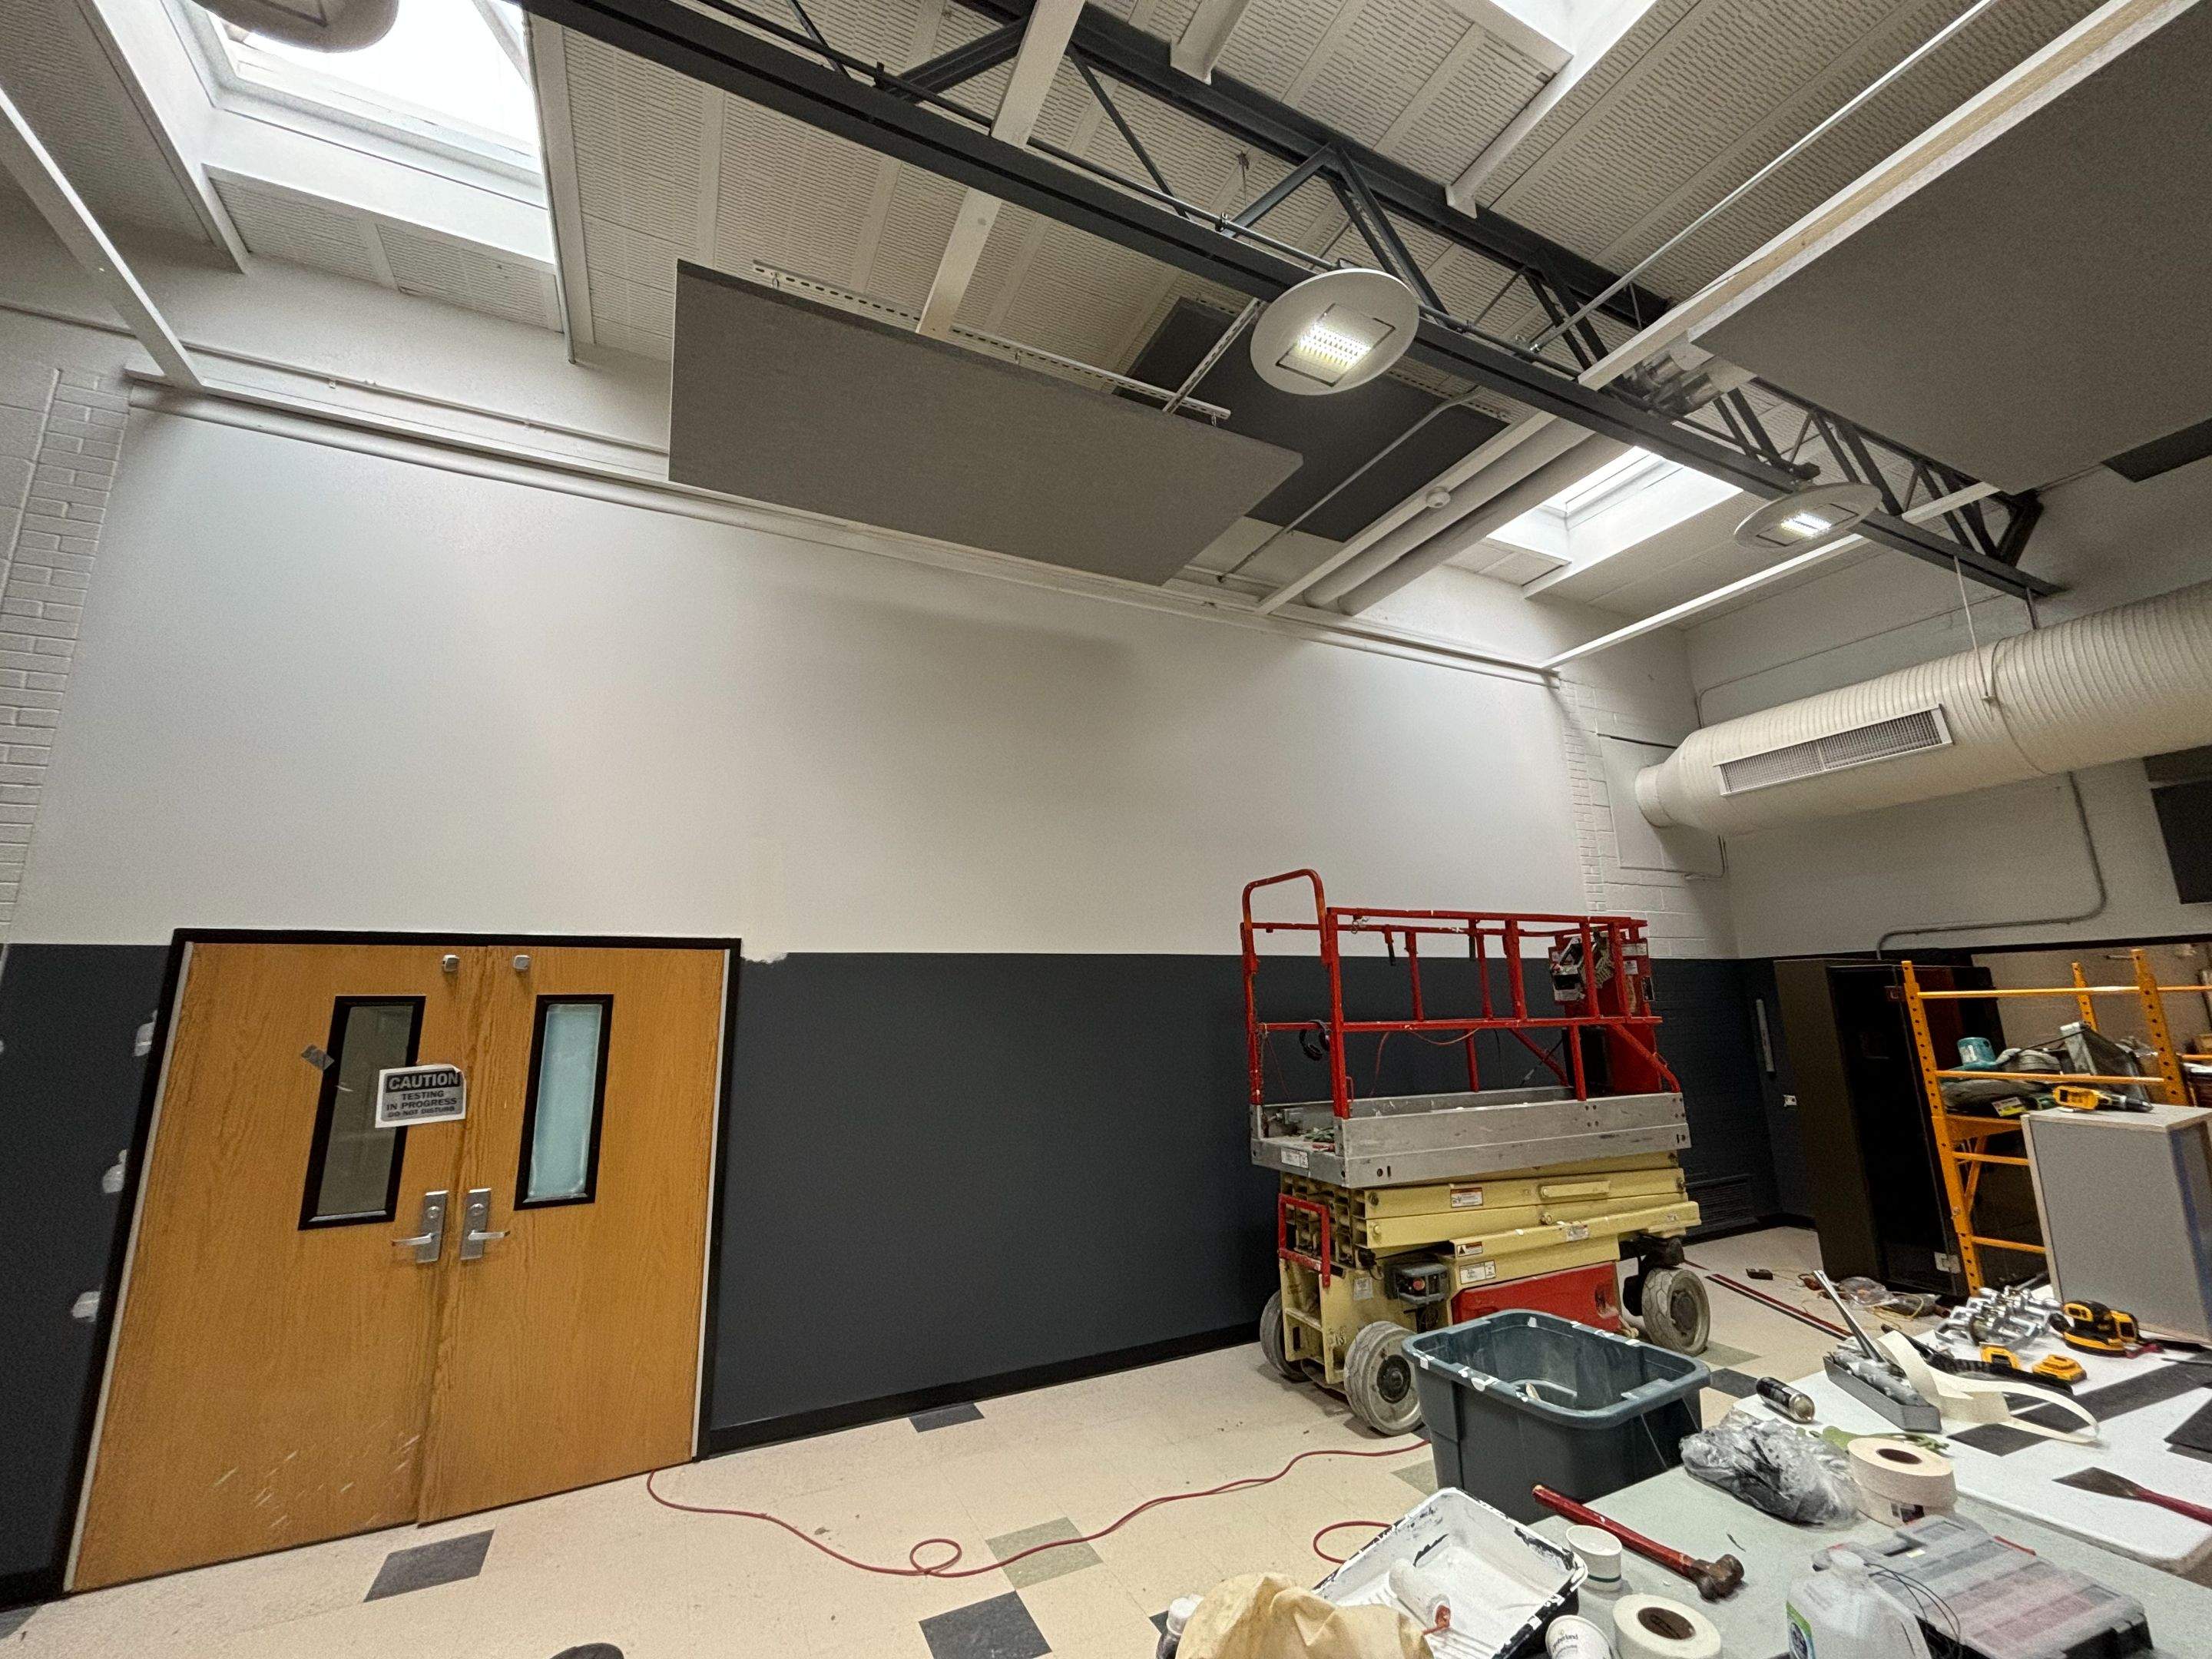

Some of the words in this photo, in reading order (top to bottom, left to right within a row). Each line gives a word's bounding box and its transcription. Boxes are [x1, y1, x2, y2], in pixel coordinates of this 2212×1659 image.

[389, 1072, 459, 1090] CAUTION
[402, 1090, 444, 1101] TESTING
[402, 1098, 457, 1109] PROGRESS
[421, 1106, 455, 1114] DISTURB
